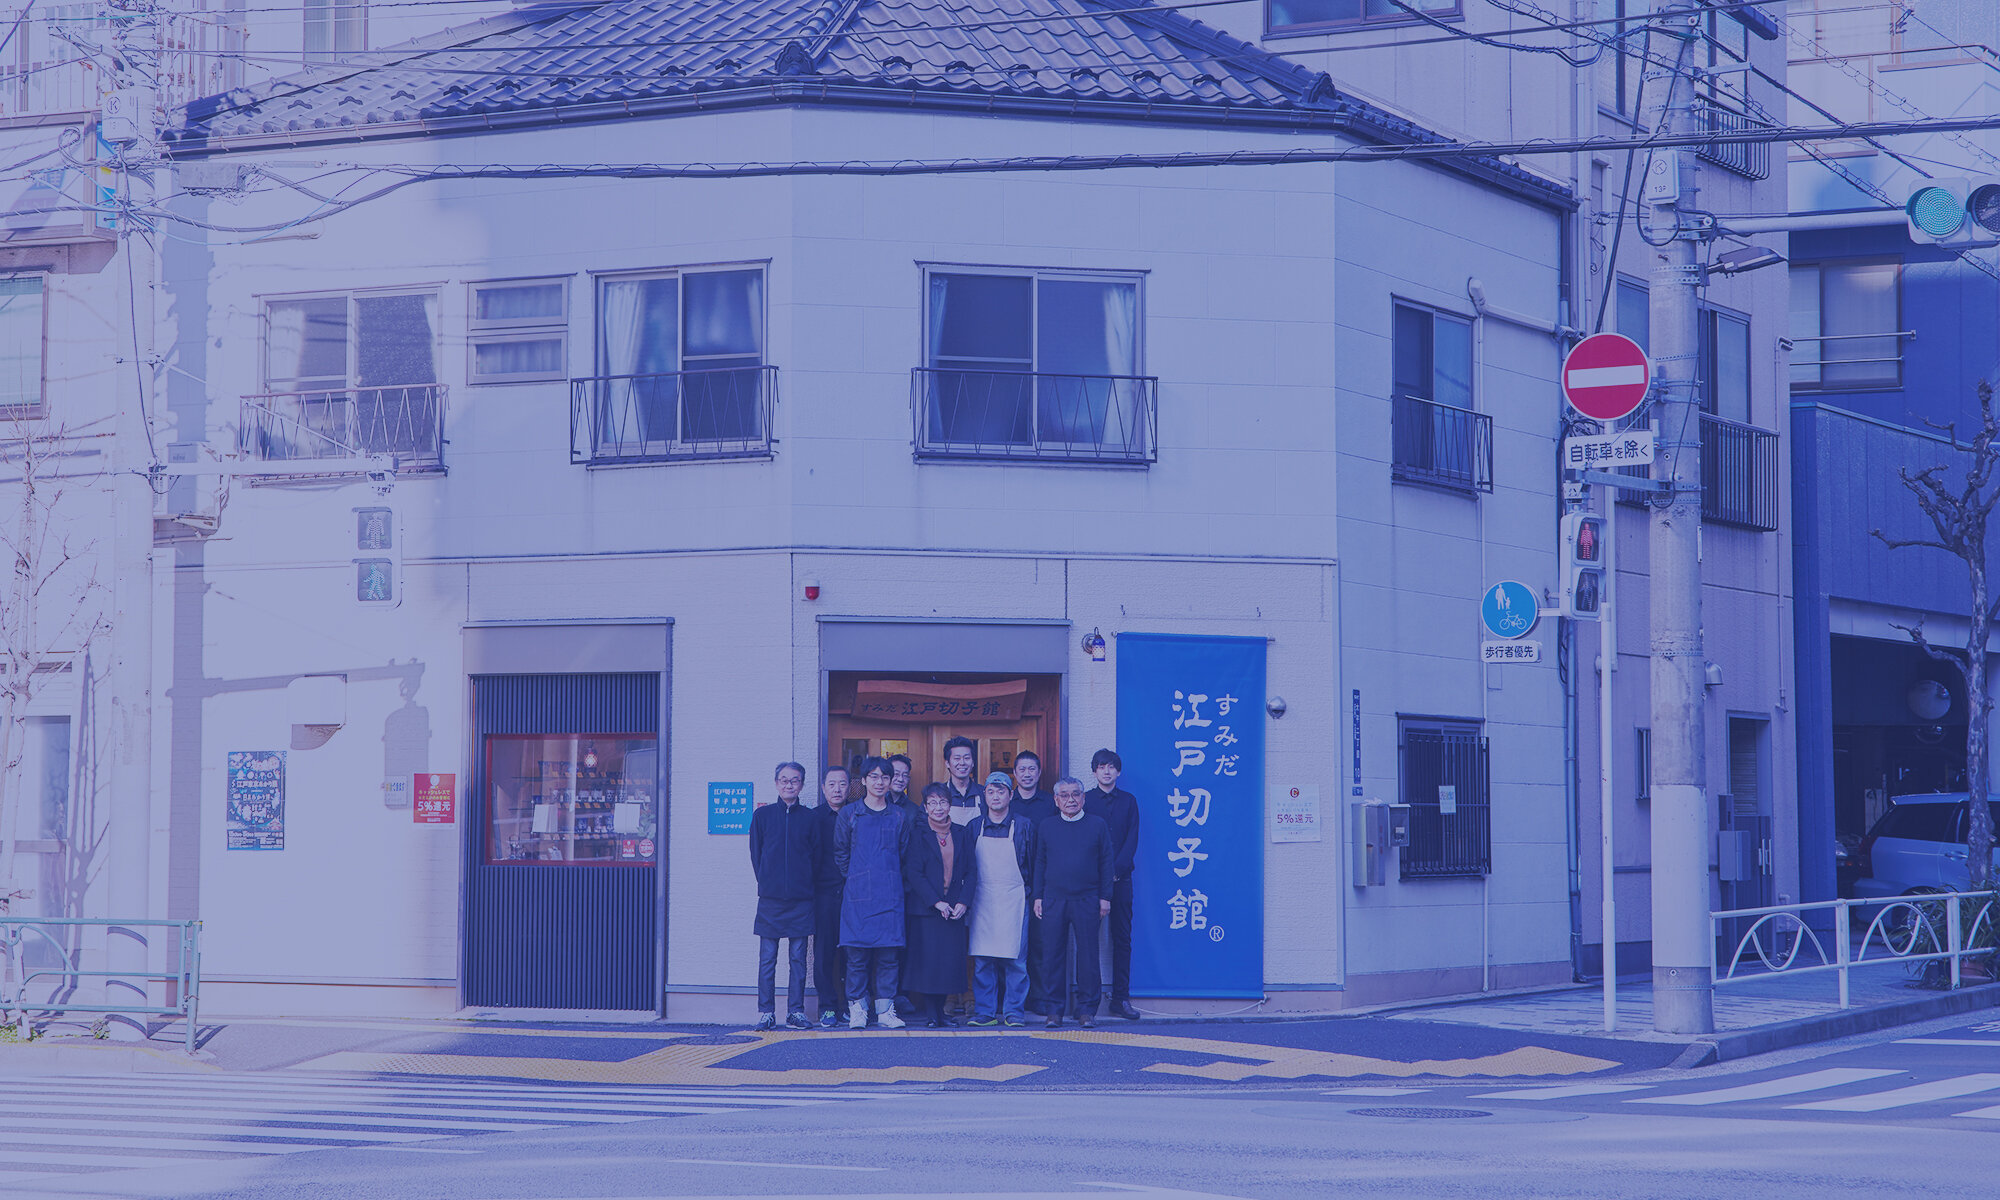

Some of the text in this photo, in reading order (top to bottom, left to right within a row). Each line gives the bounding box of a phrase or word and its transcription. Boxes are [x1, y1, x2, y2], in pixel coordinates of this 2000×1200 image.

[1570, 440, 1648, 462] 自転車を除く
[1485, 645, 1534, 658] 歩行者優先
[1213, 693, 1240, 776] すみだ
[1166, 689, 1213, 931] 江戸切子館
[1277, 813, 1314, 824] 5%還元
